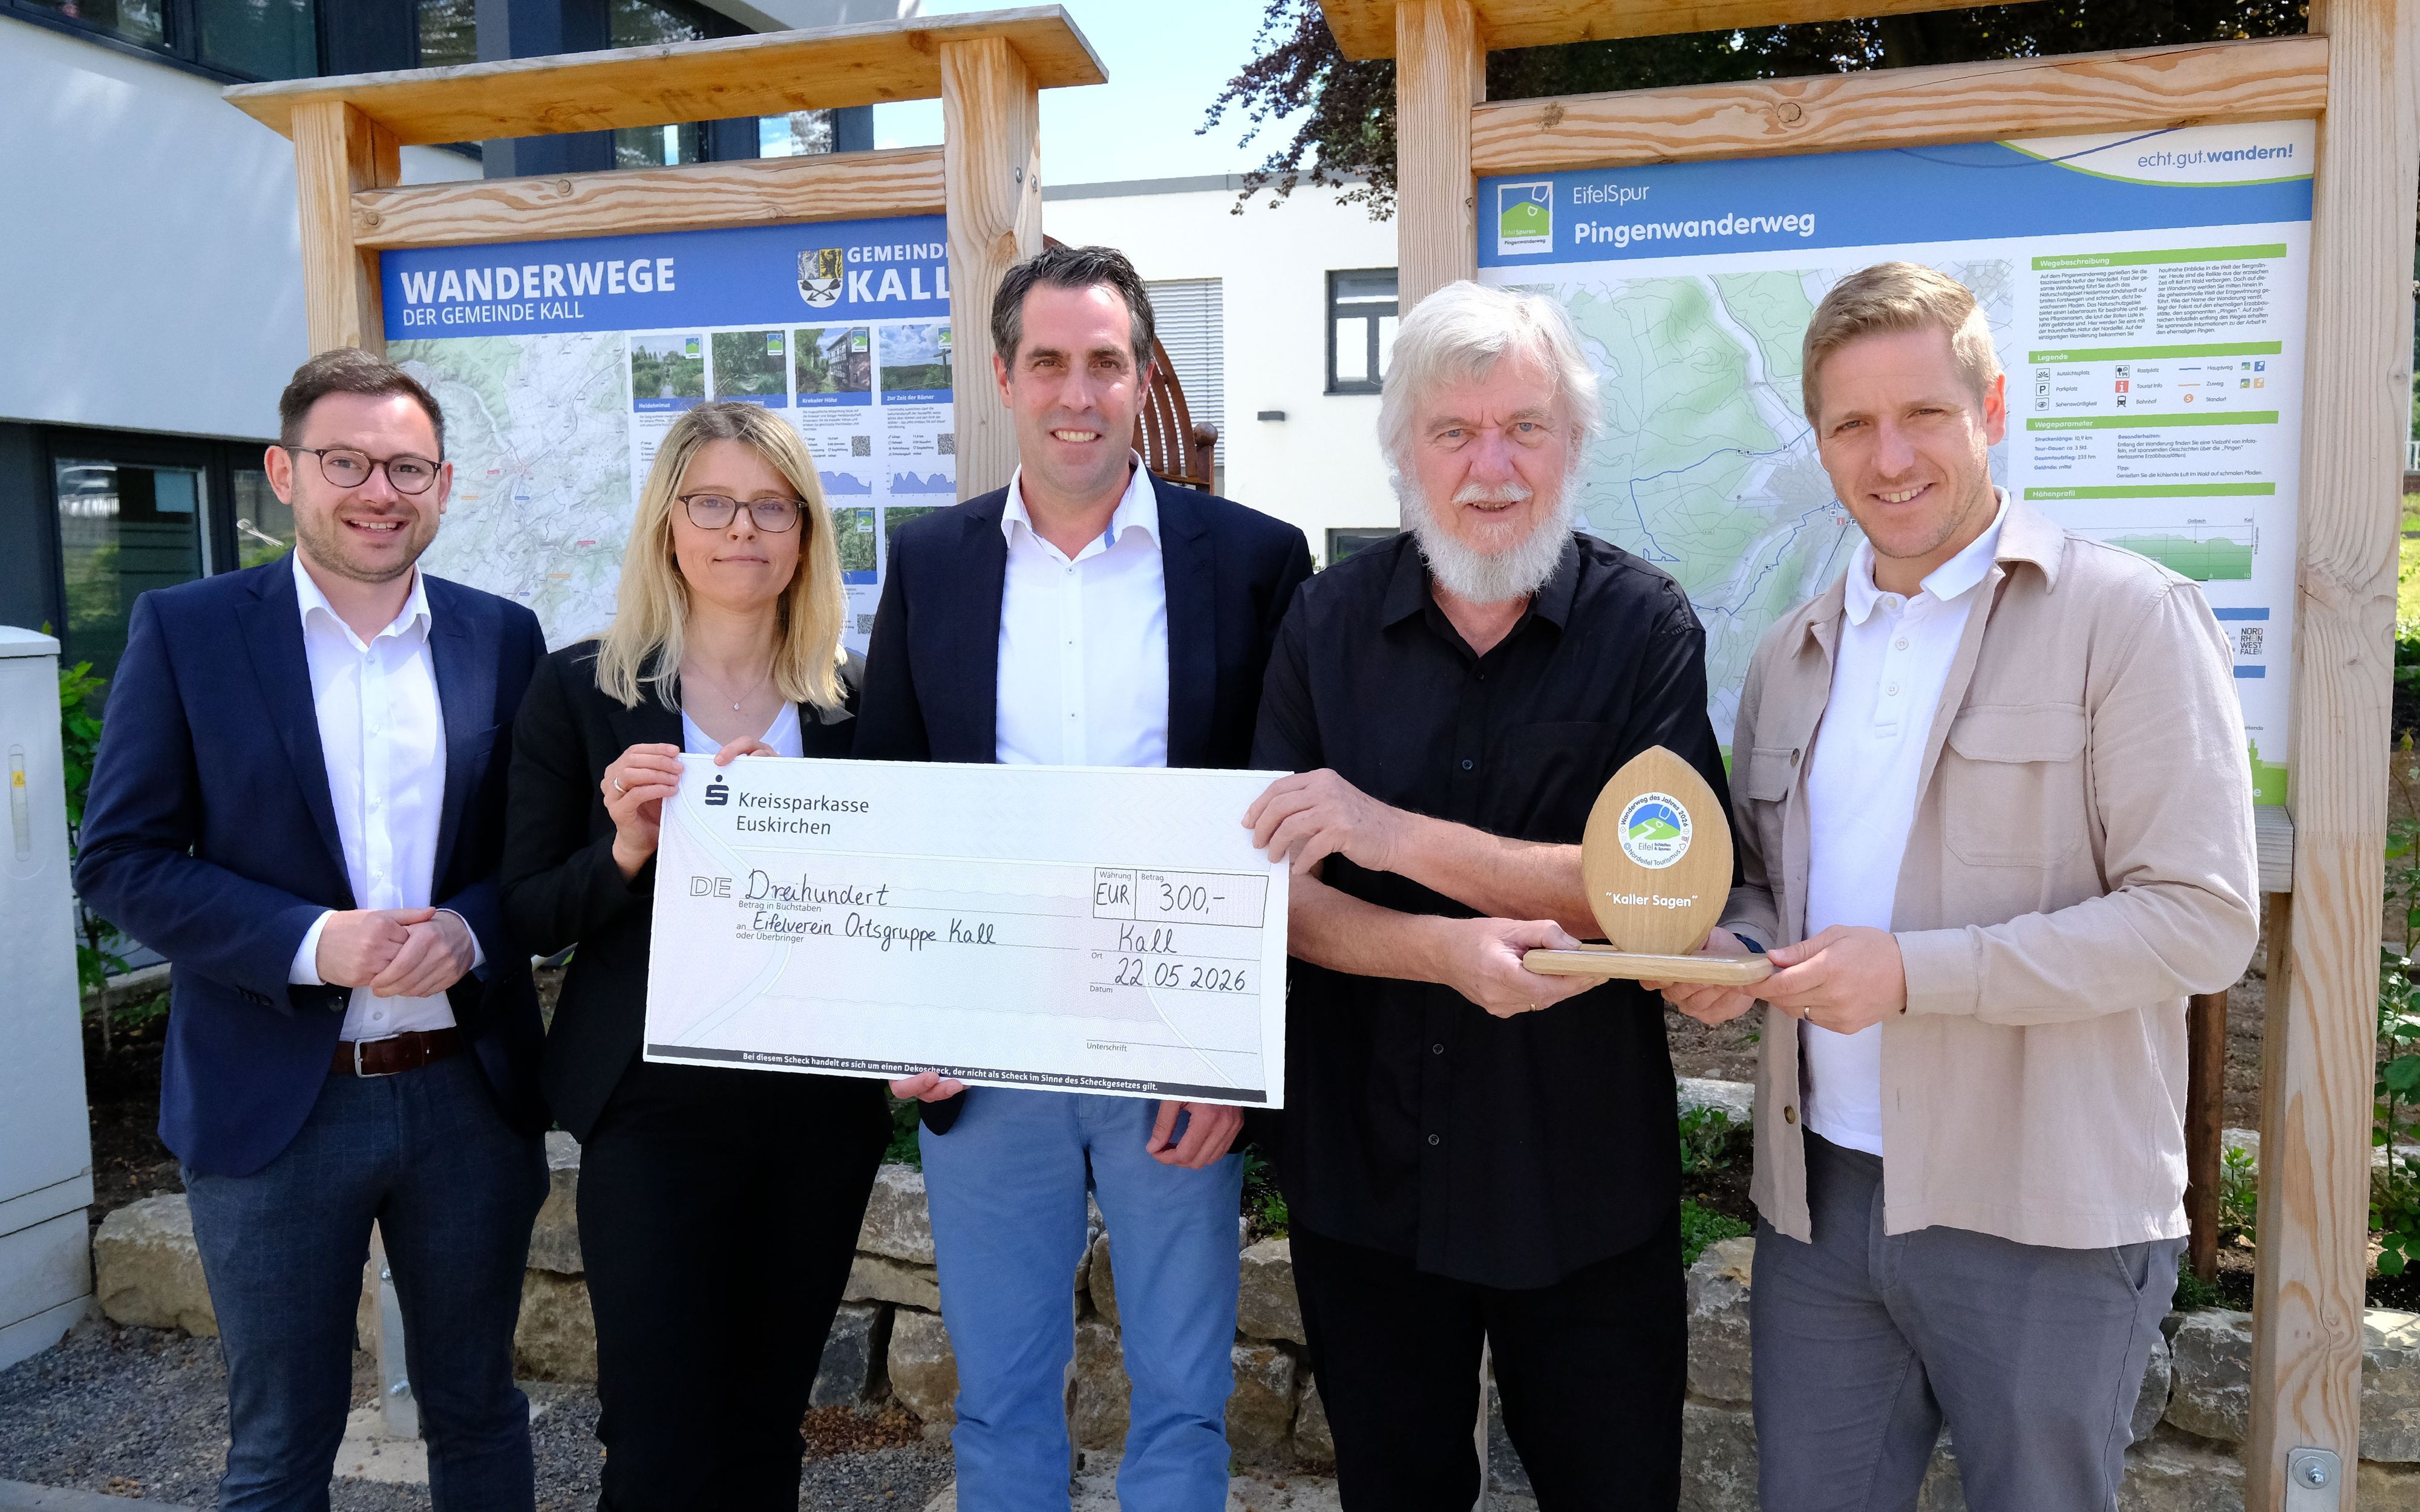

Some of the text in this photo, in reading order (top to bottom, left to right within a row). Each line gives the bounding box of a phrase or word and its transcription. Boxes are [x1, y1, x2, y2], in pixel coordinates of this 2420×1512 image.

[2138, 143, 2293, 168] echt.gut.wandern!
[1573, 184, 1650, 206] EifelSpur
[1575, 213, 1815, 248] Pingenwanderweg
[848, 243, 948, 262] GEMEIND
[2040, 257, 2110, 267] Wegebeschreibung
[400, 257, 675, 304] WANDERWEGE
[848, 266, 950, 303] KALL
[403, 301, 584, 326] DER GEMEINDE KALL
[738, 792, 869, 813] Kreissparkasse
[1621, 797, 1648, 825] Wanderweg
[1661, 797, 1679, 811] Jahres
[1678, 810, 1689, 827] 2026
[736, 815, 831, 835] Euskirchen
[1628, 849, 1681, 865] Nordeifel Tourismus
[1099, 871, 1131, 881] Währung
[1141, 873, 1164, 882] Betrag
[690, 876, 732, 899] DE
[745, 868, 889, 907] Dreihundert
[1096, 883, 1130, 905] EUR
[1160, 883, 1225, 914] 300,-
[738, 901, 822, 913] Betrag in Buchstaben
[736, 931, 804, 943] oder Überbringer
[753, 911, 996, 951] Eifelverein Ortsgruppe Kall
[1119, 923, 1177, 953] Kall
[1087, 1042, 1127, 1052] Unterschrift
[756, 1054, 783, 1063] diesem
[784, 1056, 810, 1064] Scheck
[811, 1058, 839, 1067] handelt
[851, 1060, 866, 1069] sich
[881, 1063, 902, 1072] einen
[904, 1064, 950, 1075] Dekoscheck,
[952, 1068, 965, 1077] der
[967, 1069, 987, 1078] nicht
[988, 1070, 999, 1079] als
[1001, 1072, 1028, 1081] Scheck
[1041, 1074, 1063, 1083] Sinne
[1065, 1076, 1079, 1084] des
[1080, 1077, 1140, 1090] Scheckgesetzes
[1142, 1083, 1158, 1092] gilt.
